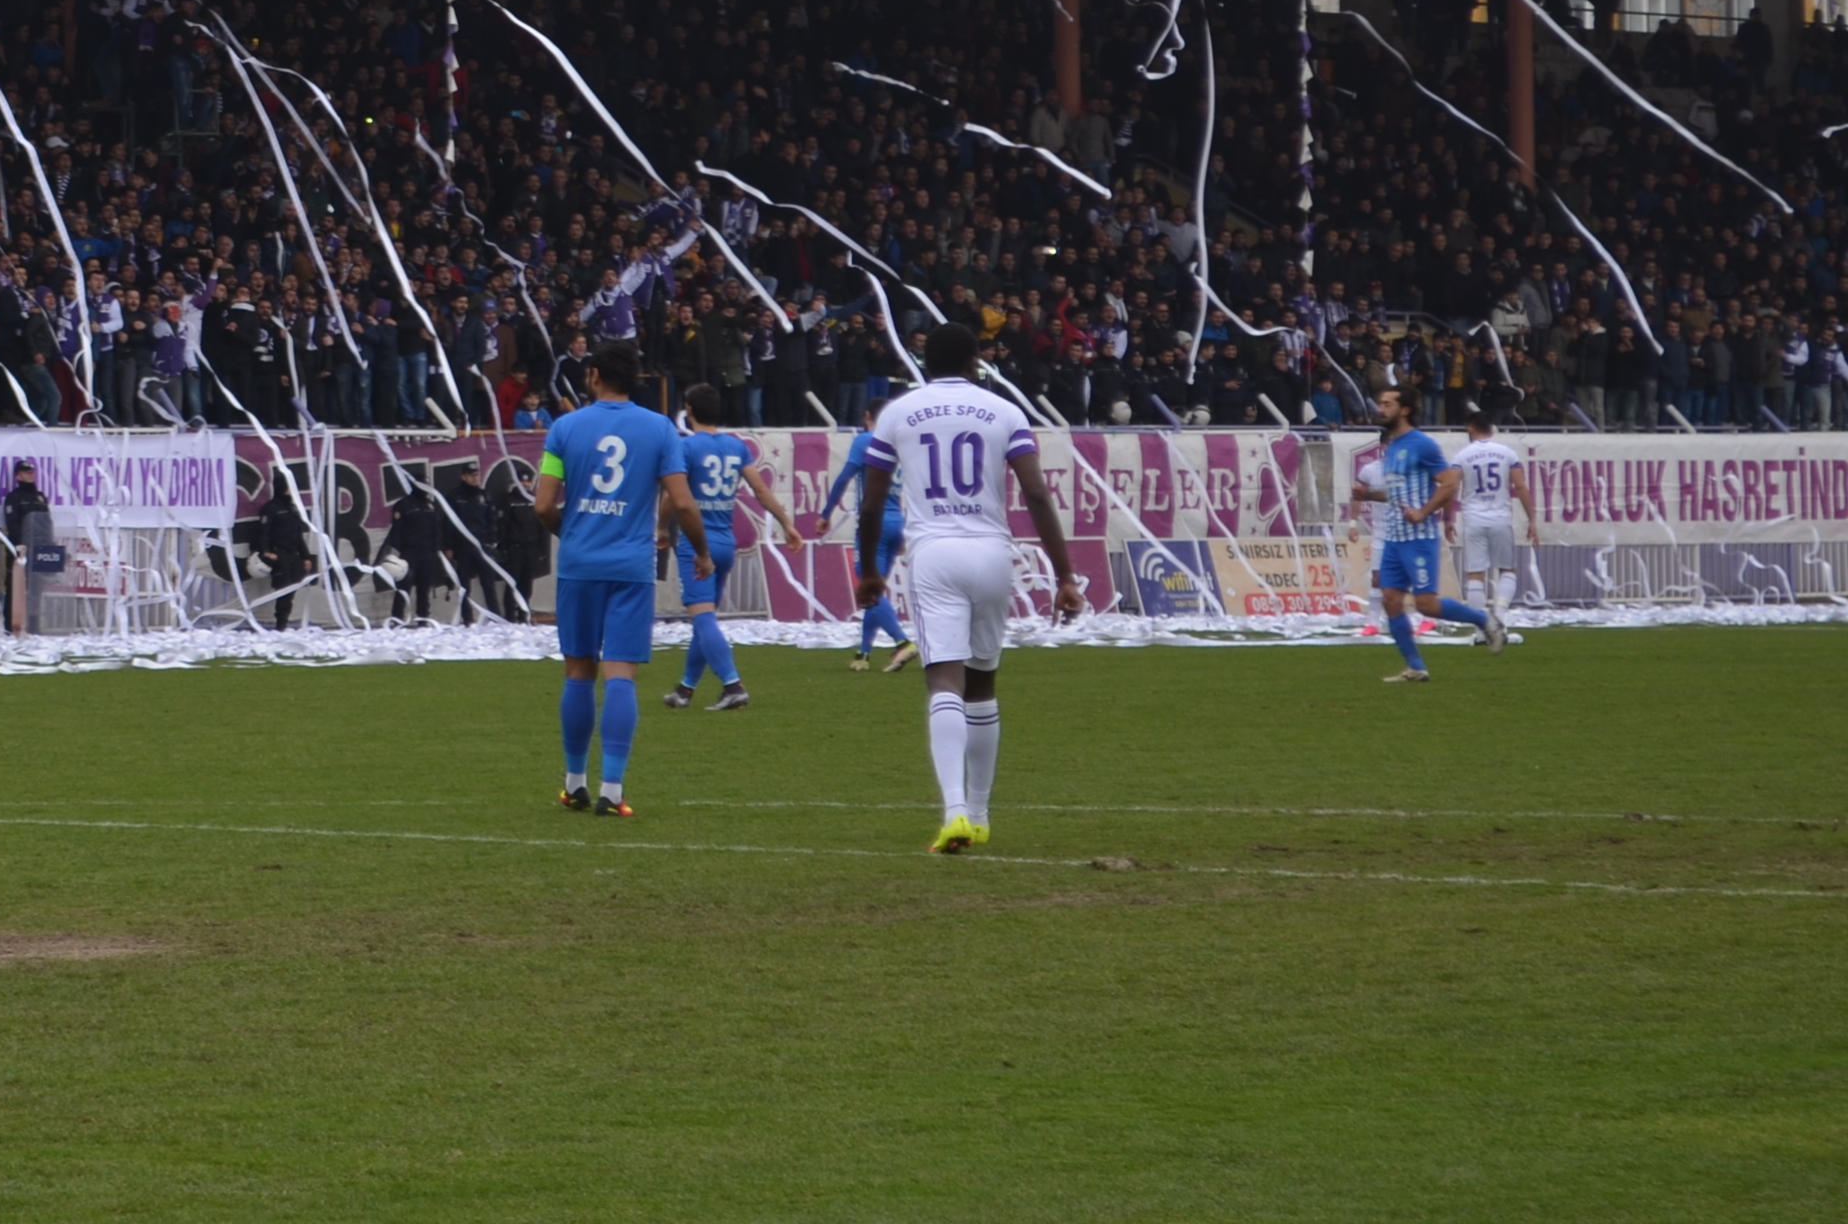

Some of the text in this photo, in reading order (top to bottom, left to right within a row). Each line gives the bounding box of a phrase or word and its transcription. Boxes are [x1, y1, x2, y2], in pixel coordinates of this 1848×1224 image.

[906, 404, 996, 427] GEBZE SPOR
[591, 434, 627, 494] 3
[700, 454, 742, 497] 35
[919, 430, 985, 500] 10
[1473, 462, 1501, 494] 15
[37, 551, 60, 562] POLİS
[1226, 544, 1283, 559] SNIRSIZ
[1308, 564, 1335, 587] 25
